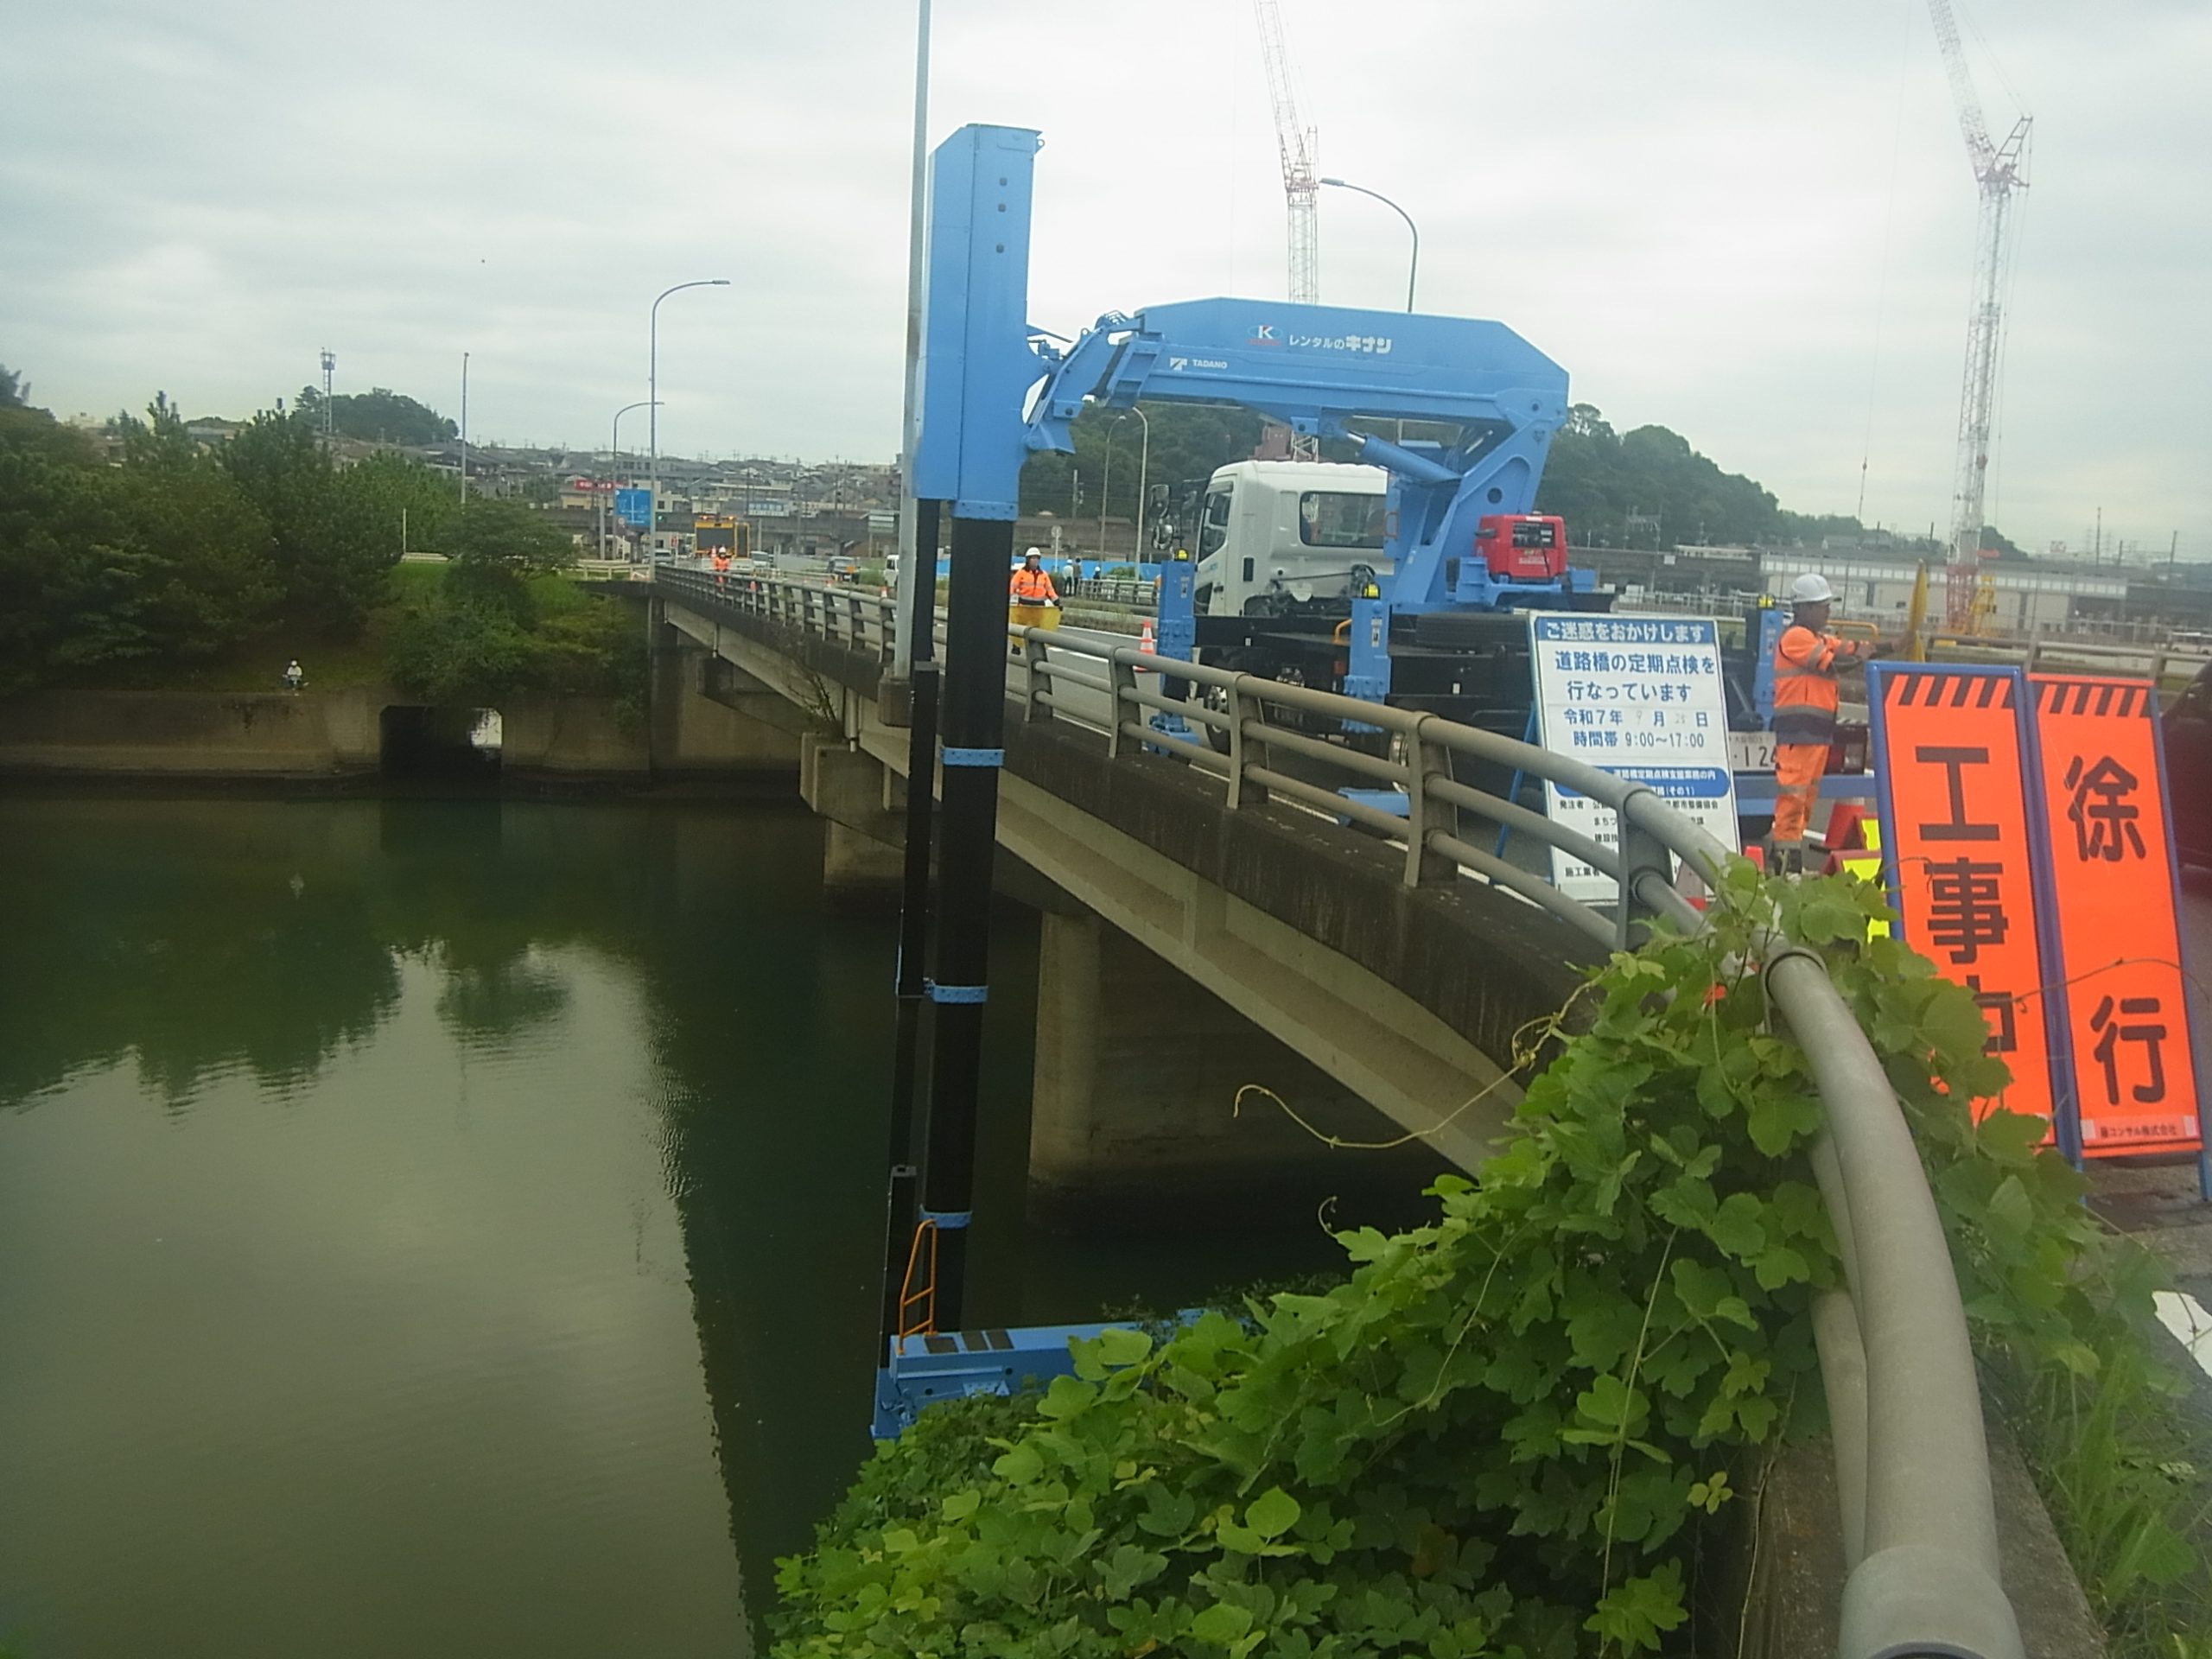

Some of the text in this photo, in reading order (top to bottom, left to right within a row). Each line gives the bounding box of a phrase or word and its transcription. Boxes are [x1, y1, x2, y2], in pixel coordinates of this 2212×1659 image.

[1192, 359, 1228, 369] TADANO
[1547, 621, 1704, 643] ご迷惑をおかけします
[1555, 651, 1715, 675] 道路橋の定期点検を
[1567, 680, 1691, 702] 行なっています
[1564, 709, 1623, 725] 令和7年
[1573, 730, 1618, 747] 時間帯
[1560, 800, 1584, 810] 発注者
[2063, 754, 2167, 1105] 徐行
